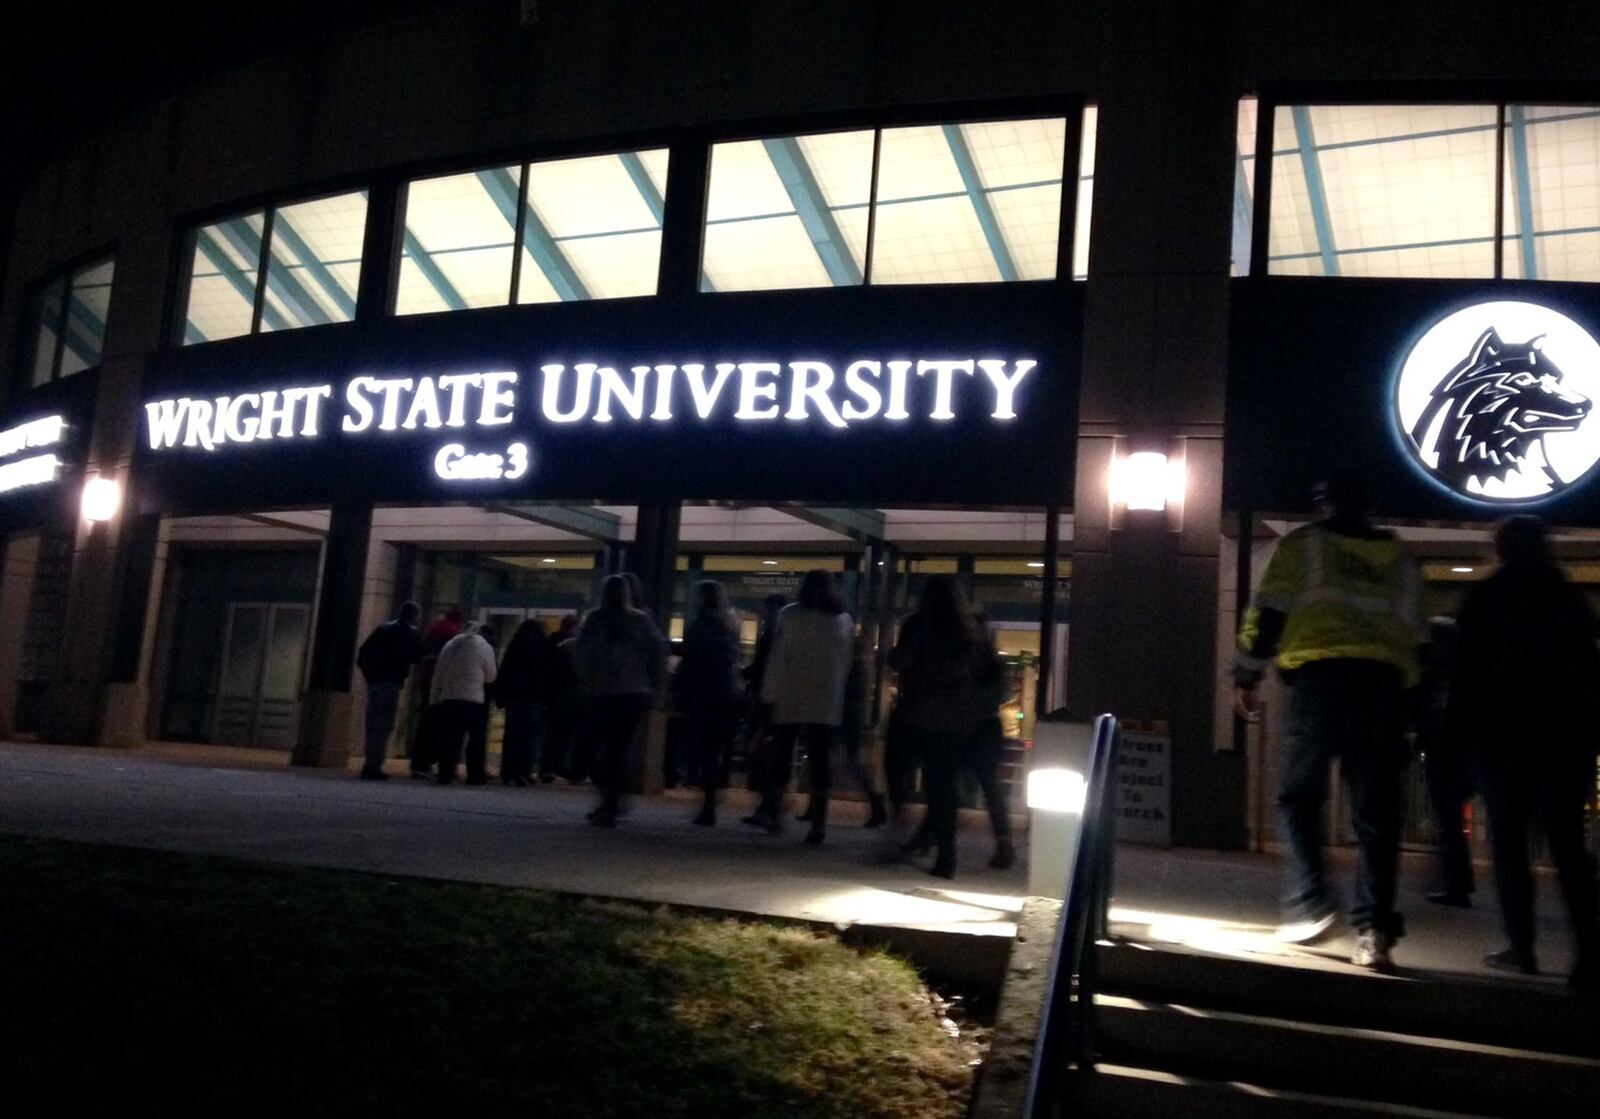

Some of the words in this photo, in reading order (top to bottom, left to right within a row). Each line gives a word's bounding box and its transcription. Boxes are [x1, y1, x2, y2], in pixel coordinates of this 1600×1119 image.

[144, 384, 331, 452] WRIGHT
[341, 371, 519, 433] STATE
[540, 359, 1038, 428] UNIVERSITY
[504, 442, 528, 480] 3
[1119, 770, 1165, 787] bject
